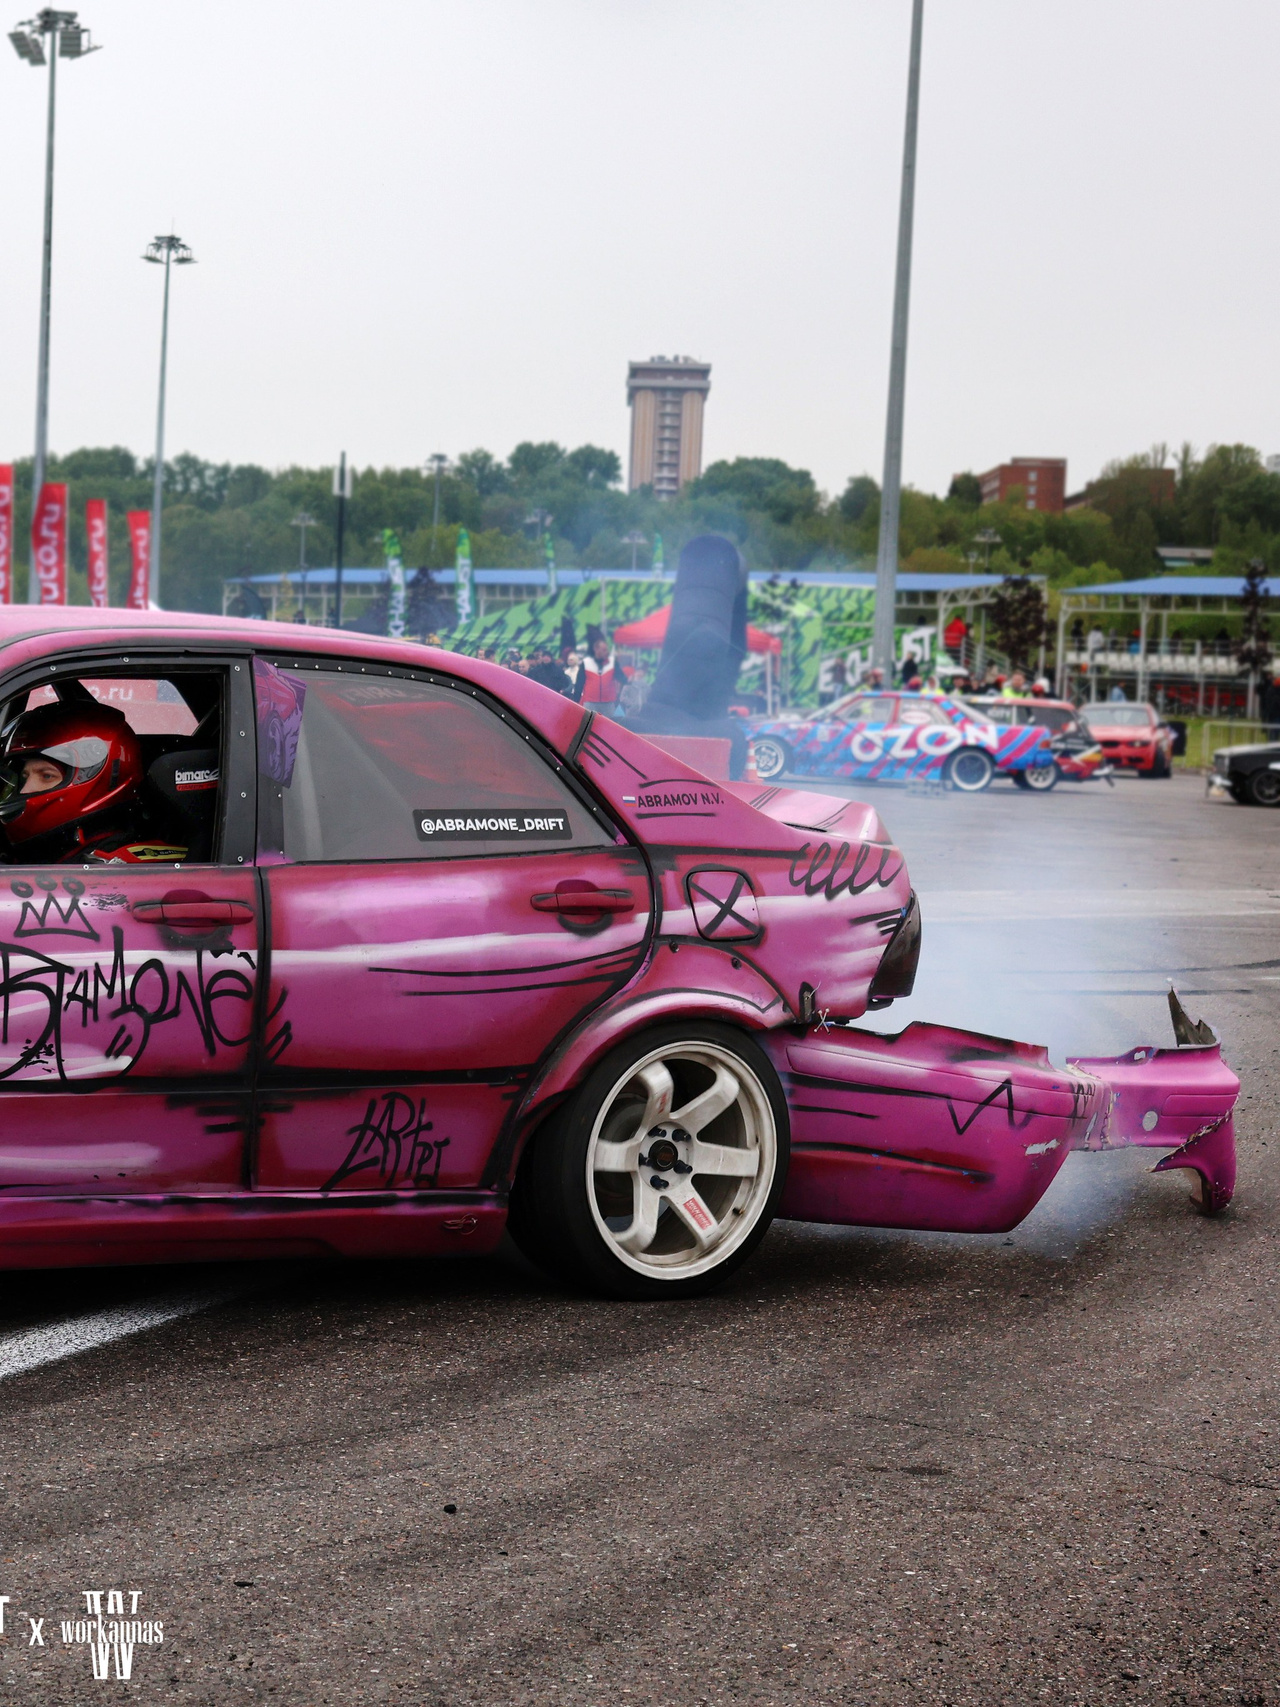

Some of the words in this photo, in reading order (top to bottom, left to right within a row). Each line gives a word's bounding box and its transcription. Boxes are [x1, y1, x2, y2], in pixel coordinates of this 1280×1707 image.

[38, 503, 61, 606] uto.ru
[851, 725, 999, 763] OZON
[637, 793, 698, 808] ABRAMOV
[701, 792, 725, 805] N.V.
[421, 818, 564, 834] @ABRAMONE_DRIFT
